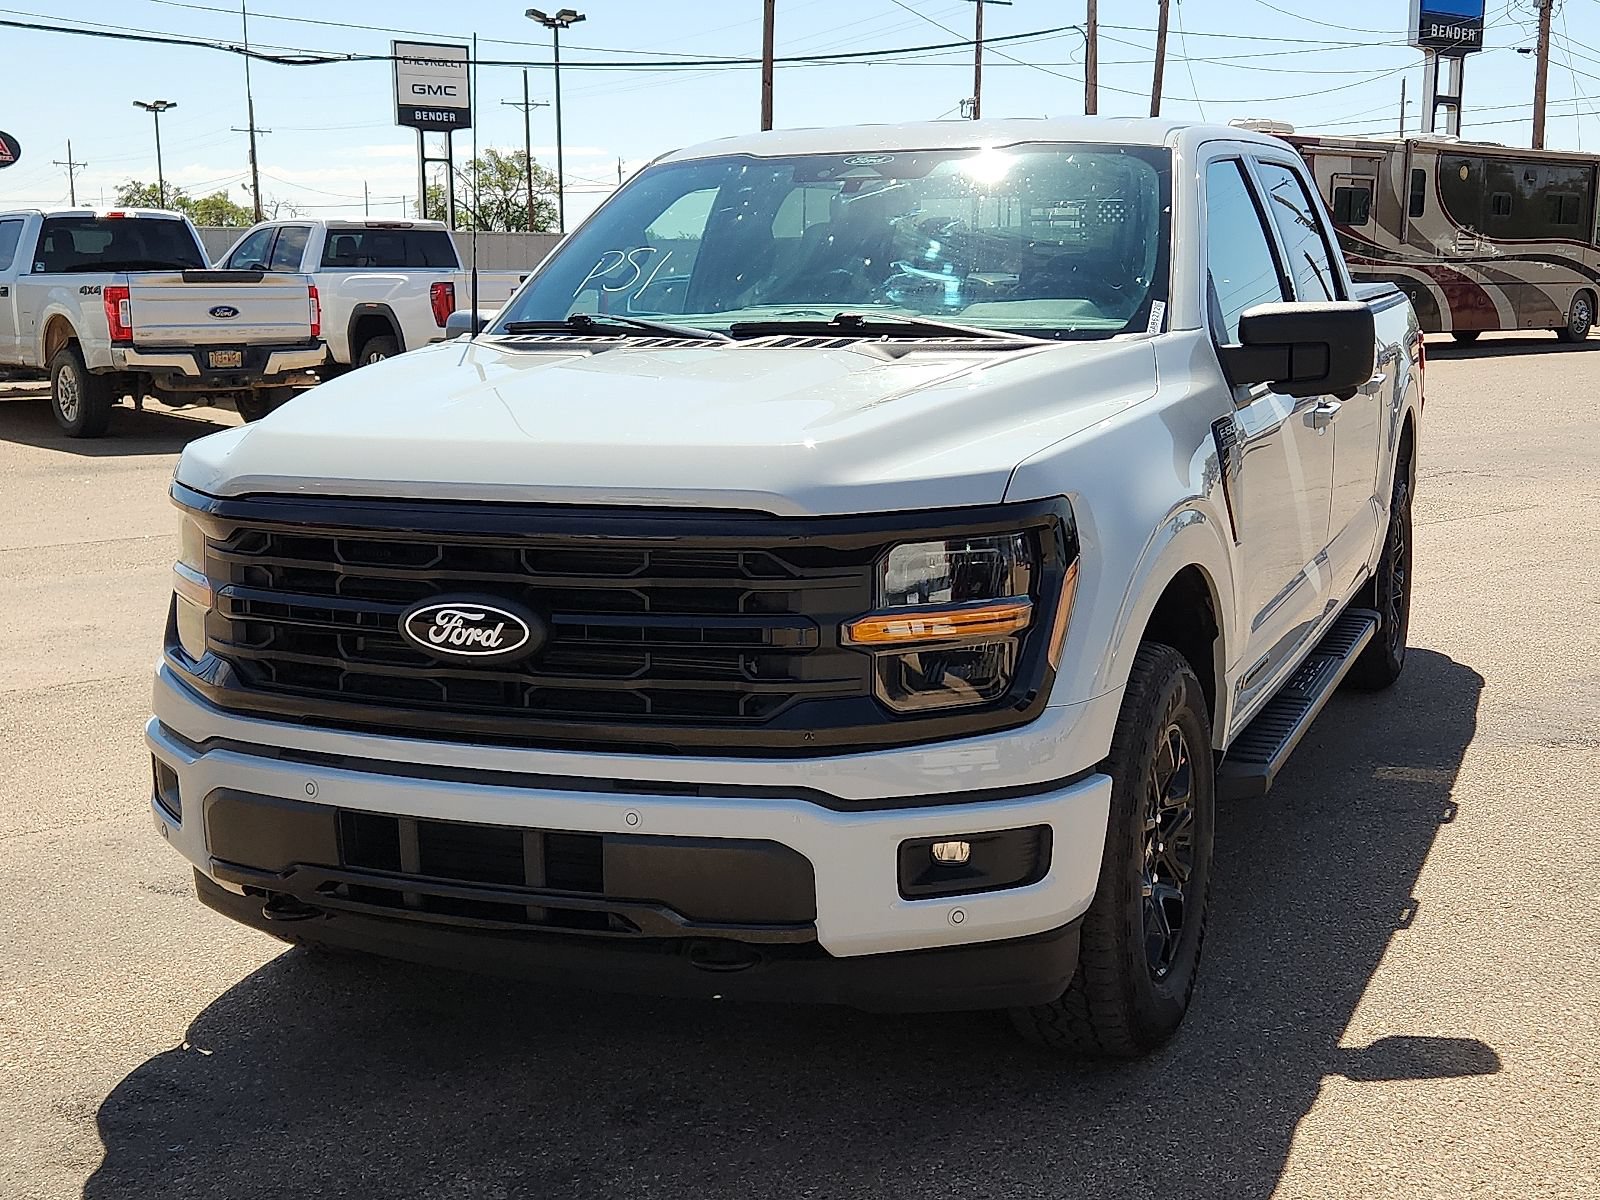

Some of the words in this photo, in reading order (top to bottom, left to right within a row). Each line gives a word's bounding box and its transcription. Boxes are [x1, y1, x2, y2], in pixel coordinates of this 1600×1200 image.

[1431, 23, 1475, 41] BENDER
[411, 83, 457, 96] GMC
[414, 111, 456, 122] BENDER
[215, 307, 233, 317] Ford
[428, 609, 505, 648] Ford
